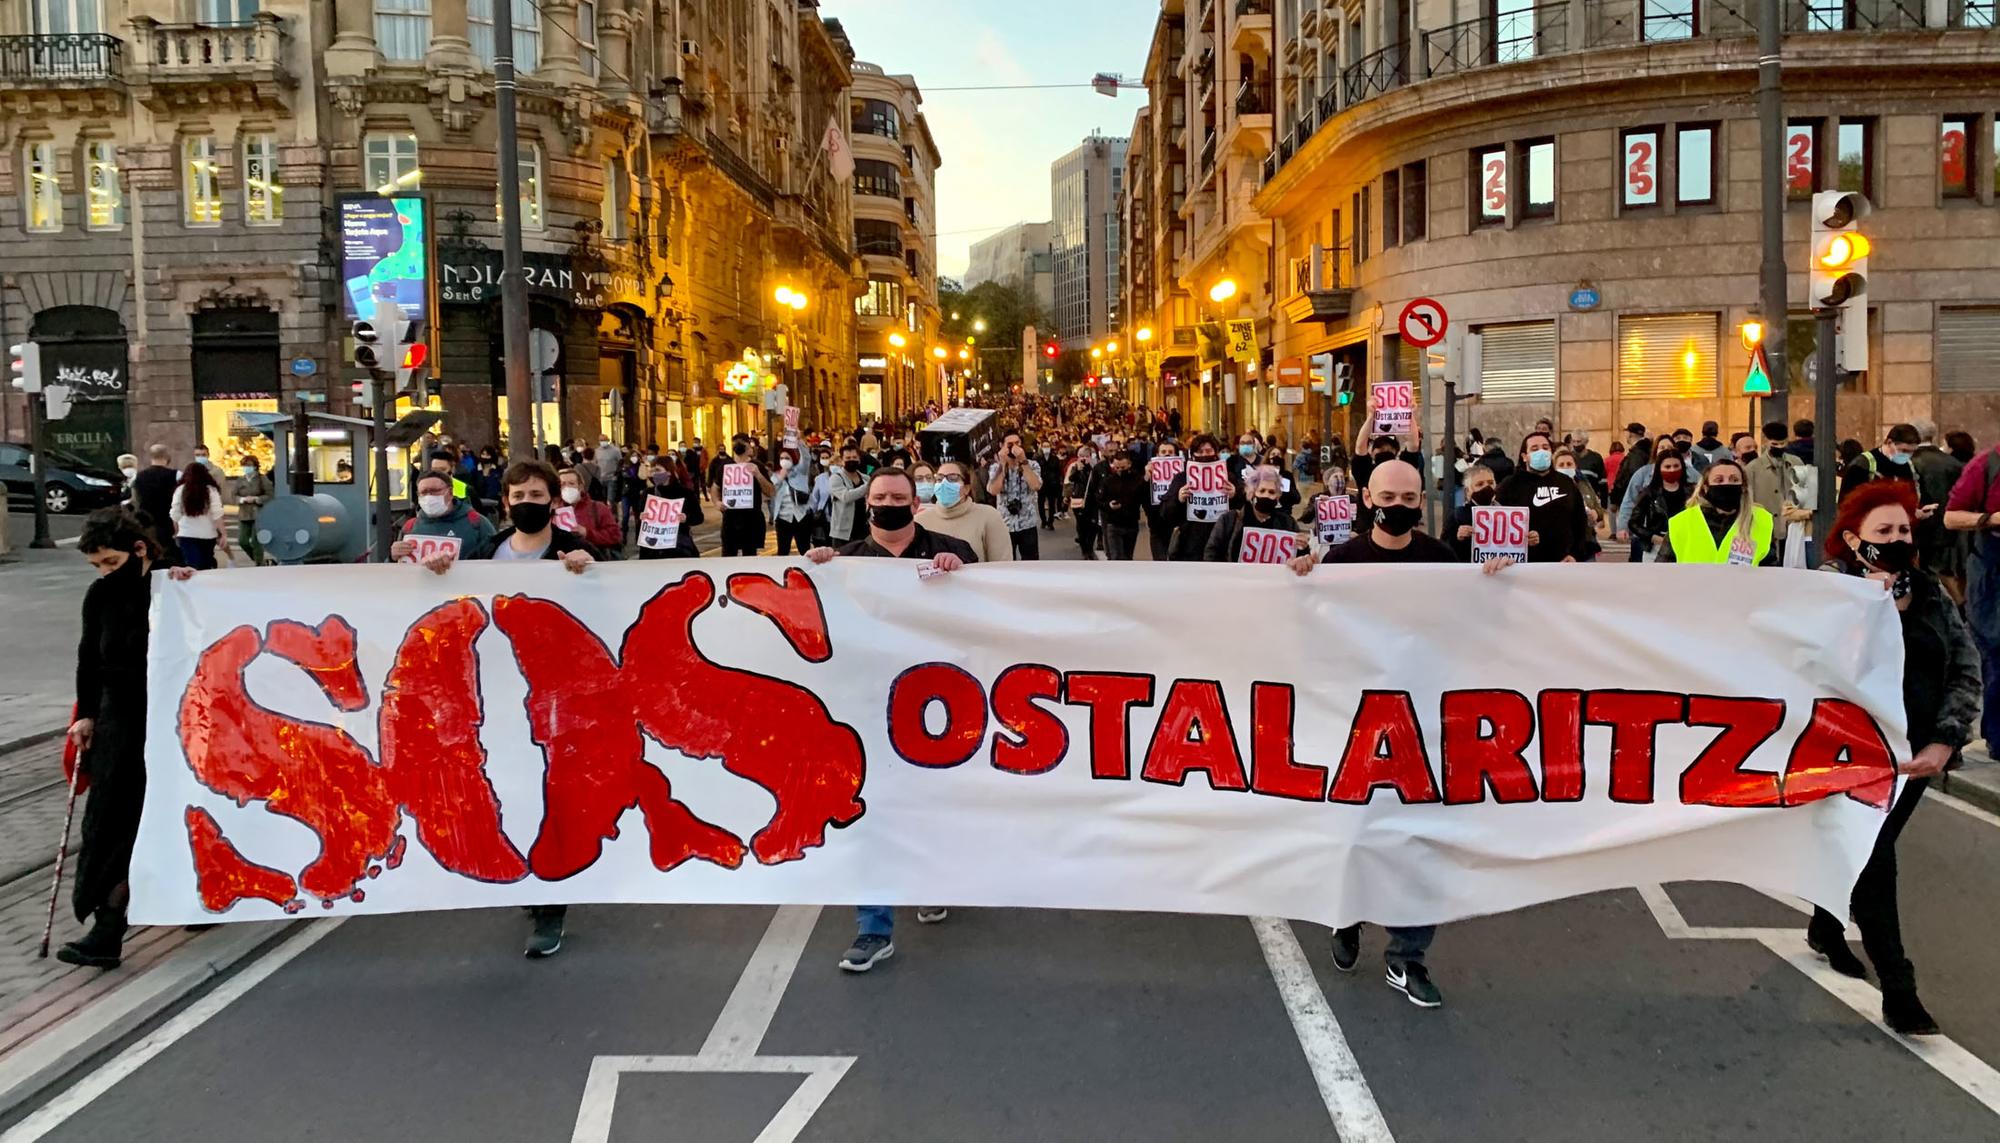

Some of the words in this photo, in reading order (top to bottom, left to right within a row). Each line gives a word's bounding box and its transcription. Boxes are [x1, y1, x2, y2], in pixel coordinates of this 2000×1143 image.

[1236, 342, 1248, 351] 62
[1376, 386, 1409, 408] SOS
[724, 466, 753, 485] SOS
[1153, 461, 1181, 480] SOS
[1188, 465, 1226, 491] SOS
[1537, 486, 1560, 498] NIKE
[646, 499, 681, 523] SOS
[1318, 499, 1348, 520] SOS
[1474, 511, 1524, 545] SOS
[1242, 532, 1294, 564] SOS
[177, 568, 866, 914] SOS
[886, 661, 1897, 812] OSTALARITZA
